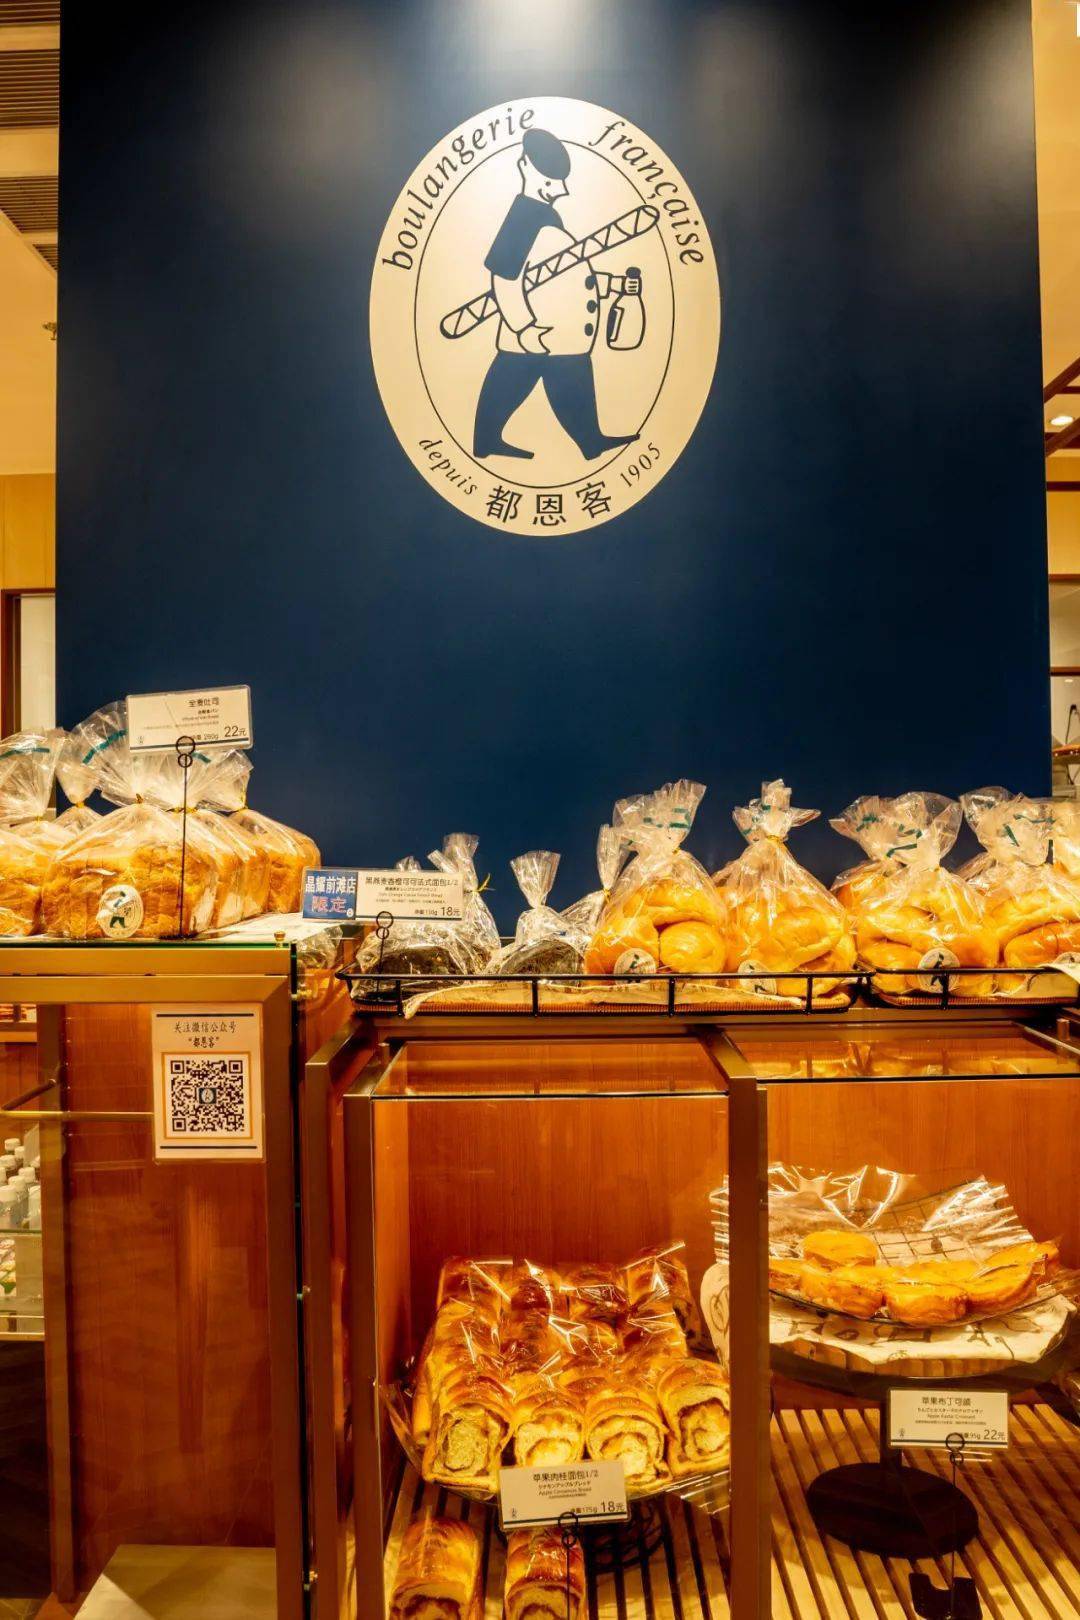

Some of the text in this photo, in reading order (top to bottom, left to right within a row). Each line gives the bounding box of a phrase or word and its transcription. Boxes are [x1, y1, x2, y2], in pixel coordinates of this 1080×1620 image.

[382, 107, 704, 271] boulangerie française
[418, 437, 662, 496] depuis 1905
[485, 483, 612, 527] 都恩客
[224, 725, 247, 738] 22元
[311, 895, 347, 914] 限定
[441, 906, 461, 917] 18元
[174, 1020, 237, 1034] 关注微信公众号
[983, 1429, 1006, 1441] 22元
[600, 1500, 625, 1512] 18元
